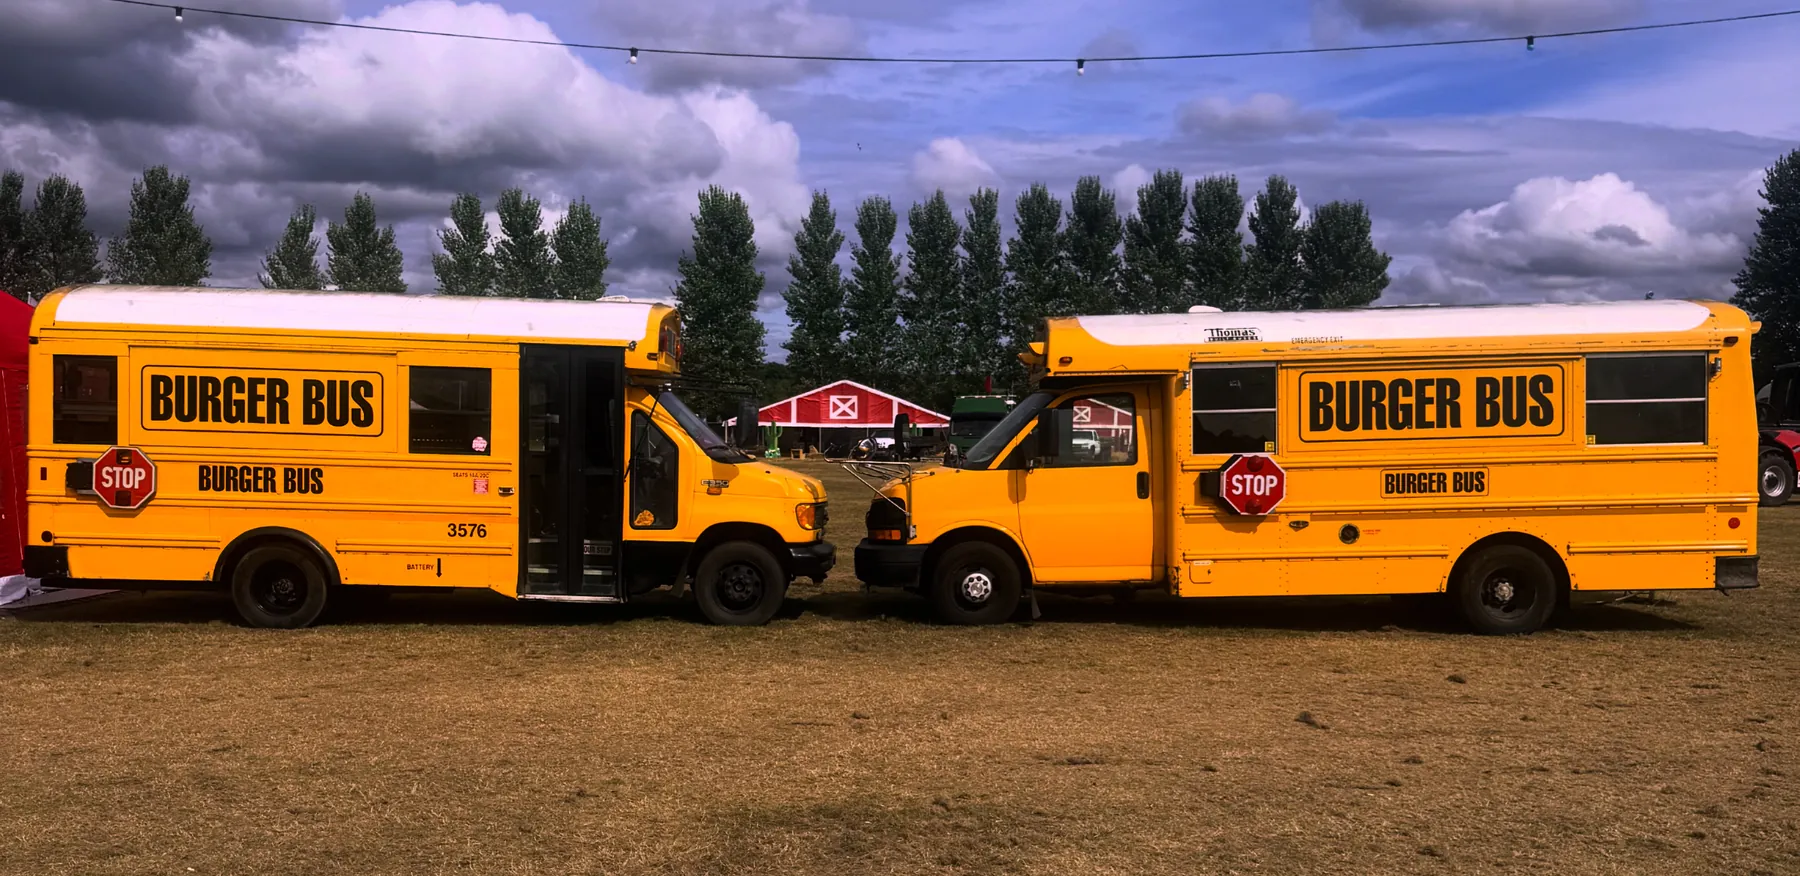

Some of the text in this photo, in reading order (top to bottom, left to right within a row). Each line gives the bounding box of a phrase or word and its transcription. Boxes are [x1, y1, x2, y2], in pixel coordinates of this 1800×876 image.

[1206, 328, 1255, 337] Thomas
[1291, 335, 1343, 344] EMERGENCY EXIT
[151, 375, 374, 427] BURGER BUS
[1309, 374, 1553, 431] BURGER BUS
[102, 466, 146, 489] STOP
[199, 465, 324, 494] BURGER BUS
[1231, 474, 1278, 496] STOP
[1384, 471, 1486, 495] BURGER BUS
[447, 523, 487, 538] 3576
[406, 563, 435, 571] BATTERY
